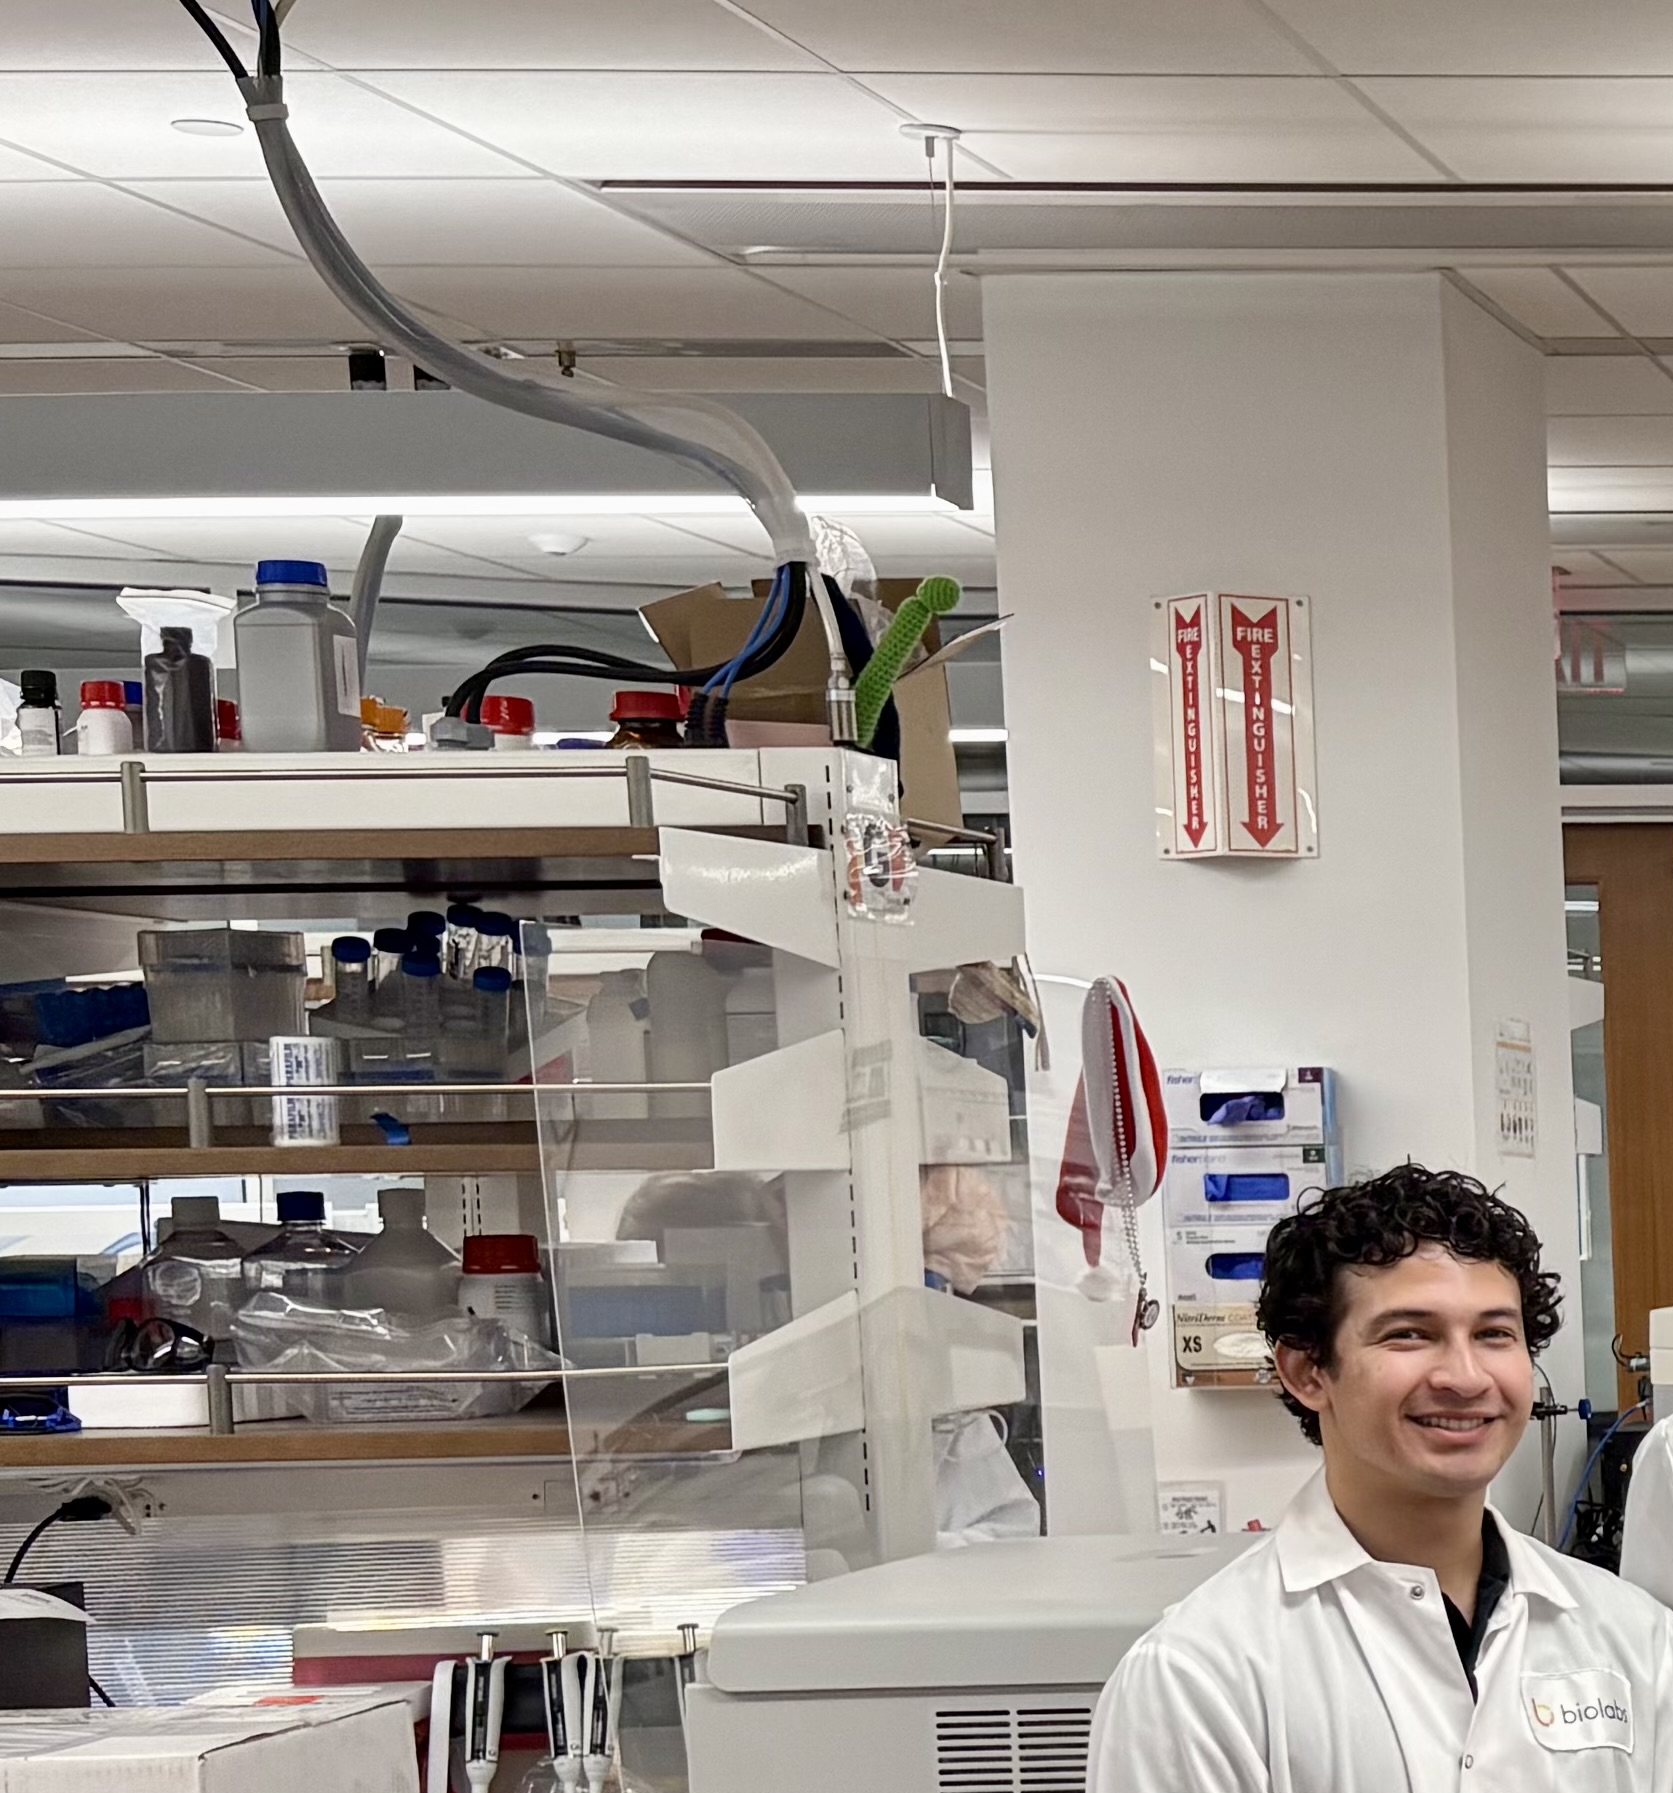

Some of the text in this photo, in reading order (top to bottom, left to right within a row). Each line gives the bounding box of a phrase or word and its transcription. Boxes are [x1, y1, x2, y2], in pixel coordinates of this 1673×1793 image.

[1177, 626, 1200, 643] FIRE
[1236, 626, 1274, 643] FIRE
[1185, 645, 1200, 830] EXTINGUISHER
[1250, 645, 1268, 830] EXTINGUISHER
[1167, 1075, 1194, 1085] fisher
[1182, 1336, 1202, 1353] XS
[1560, 1697, 1628, 1724] biolabs
